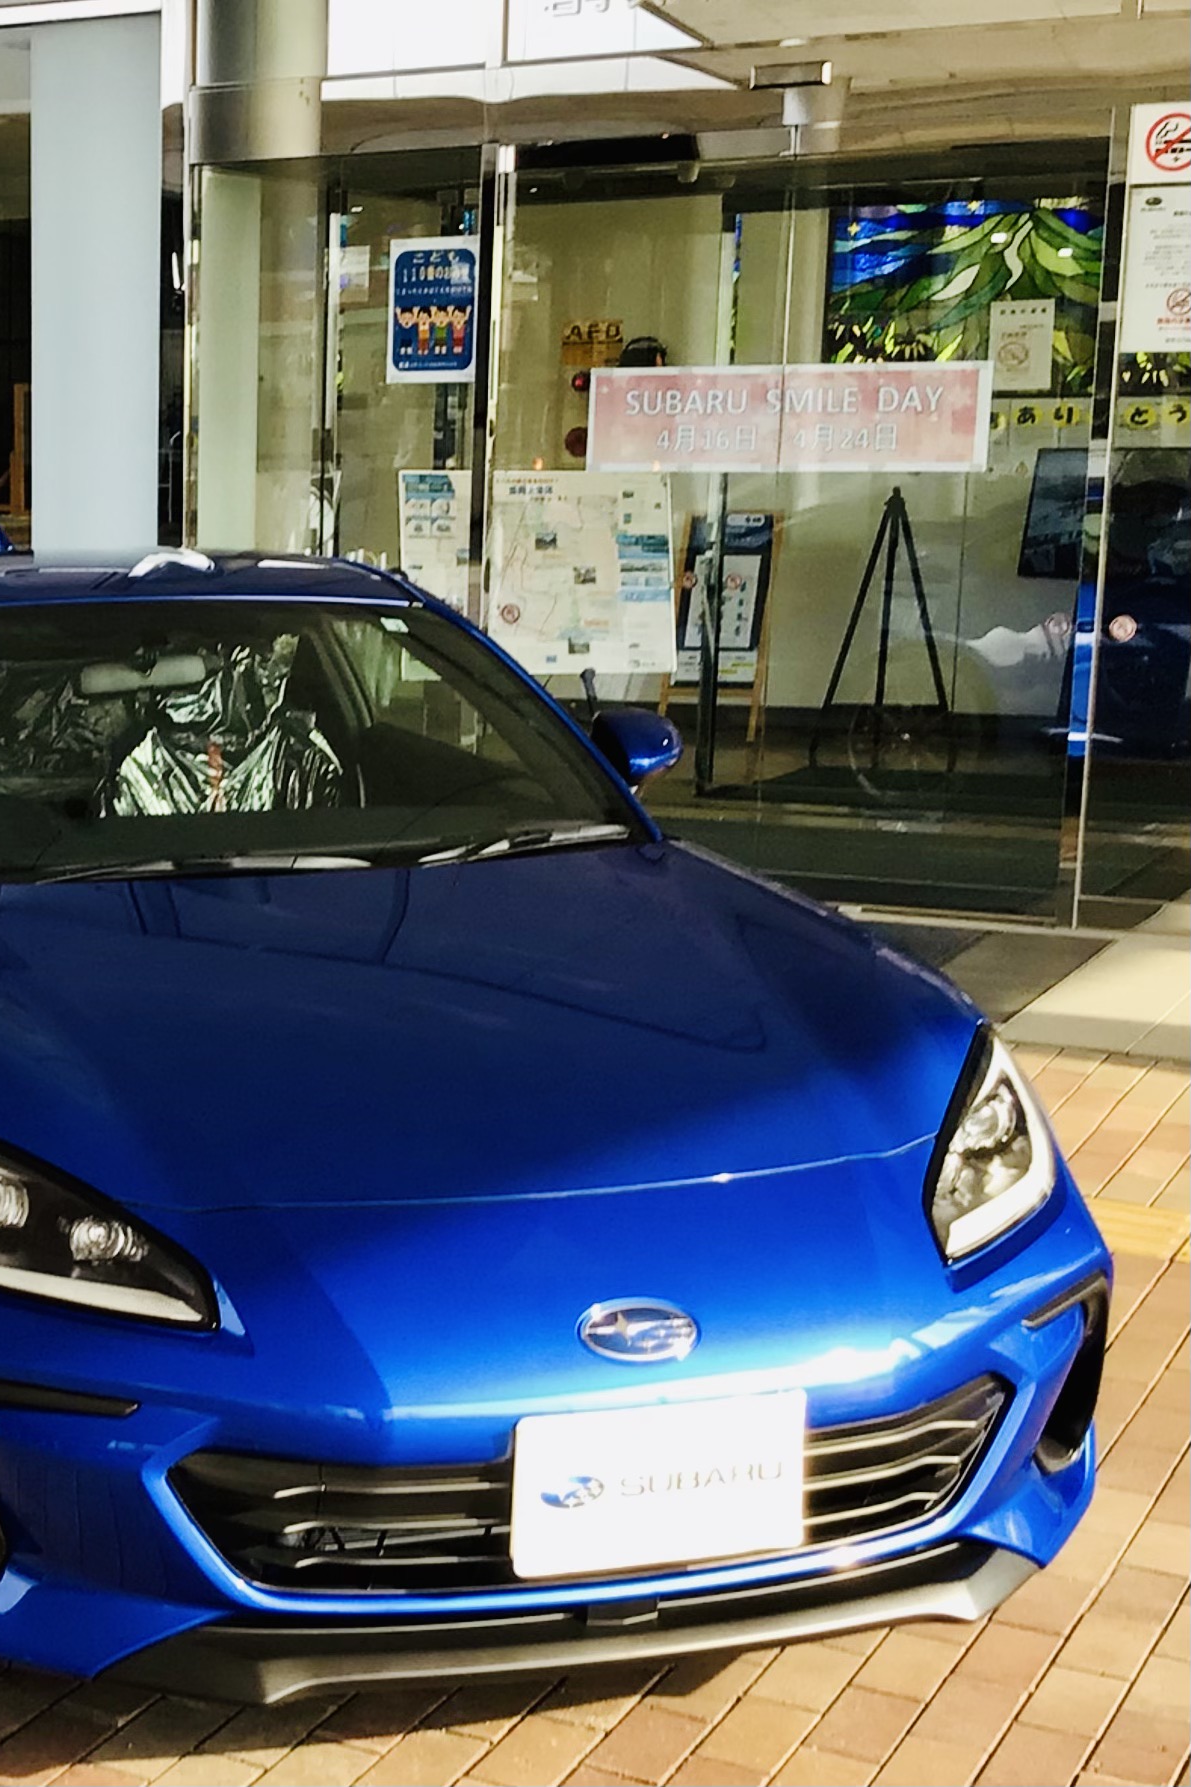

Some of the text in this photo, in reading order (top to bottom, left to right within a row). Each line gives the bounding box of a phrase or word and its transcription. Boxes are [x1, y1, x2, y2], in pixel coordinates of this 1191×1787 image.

[412, 250, 460, 264] こども
[566, 322, 621, 341] AED
[625, 386, 945, 417] SUBARU SMILE DAY
[656, 424, 897, 452] 4月16日 4月24日
[620, 1461, 783, 1496] SUBARU
